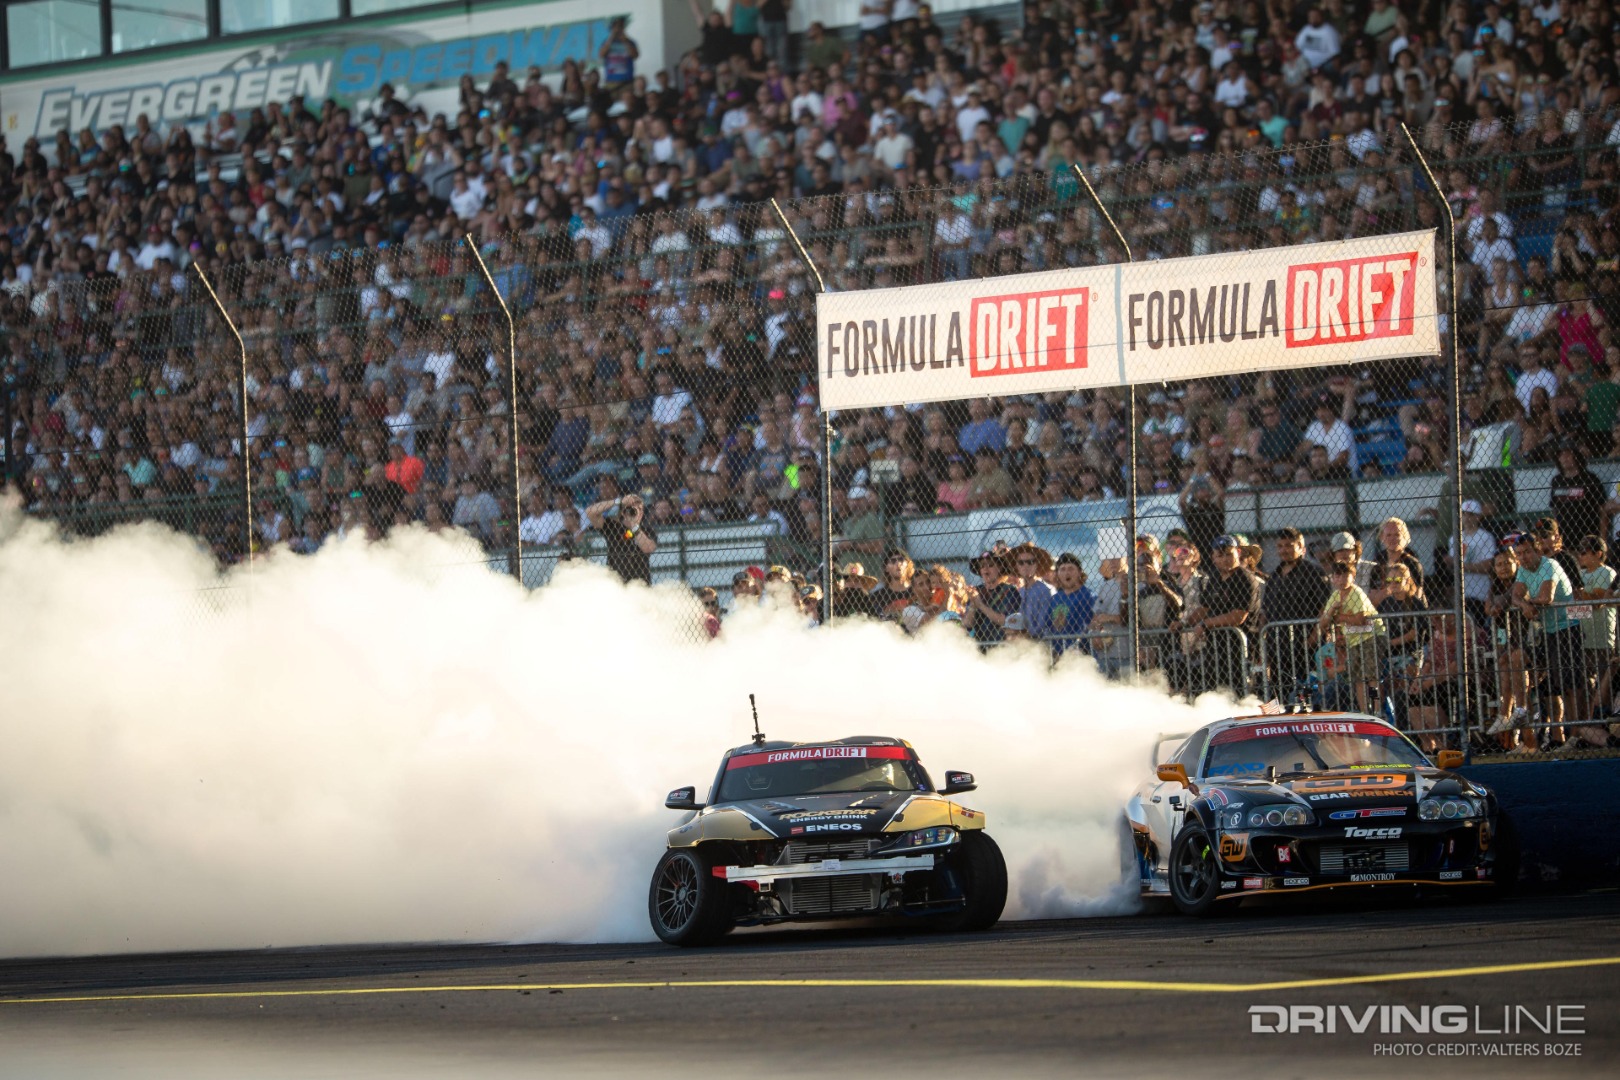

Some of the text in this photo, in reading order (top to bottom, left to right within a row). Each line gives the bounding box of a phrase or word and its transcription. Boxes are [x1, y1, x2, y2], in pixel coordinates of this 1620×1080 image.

[36, 61, 332, 138] EVERGREEN
[1128, 258, 1412, 351] FORMULA DRIFT
[827, 293, 1083, 379] FORMULA DRIFT
[1311, 723, 1355, 733] DRIFT
[768, 749, 822, 762] FORMULA
[823, 747, 866, 758] DRIFT
[779, 809, 877, 821] ROCKSTAR
[789, 815, 832, 823] ENERGY
[806, 823, 862, 832] ENEOS
[1344, 827, 1402, 838] Torco
[1360, 873, 1396, 882] MONTROY
